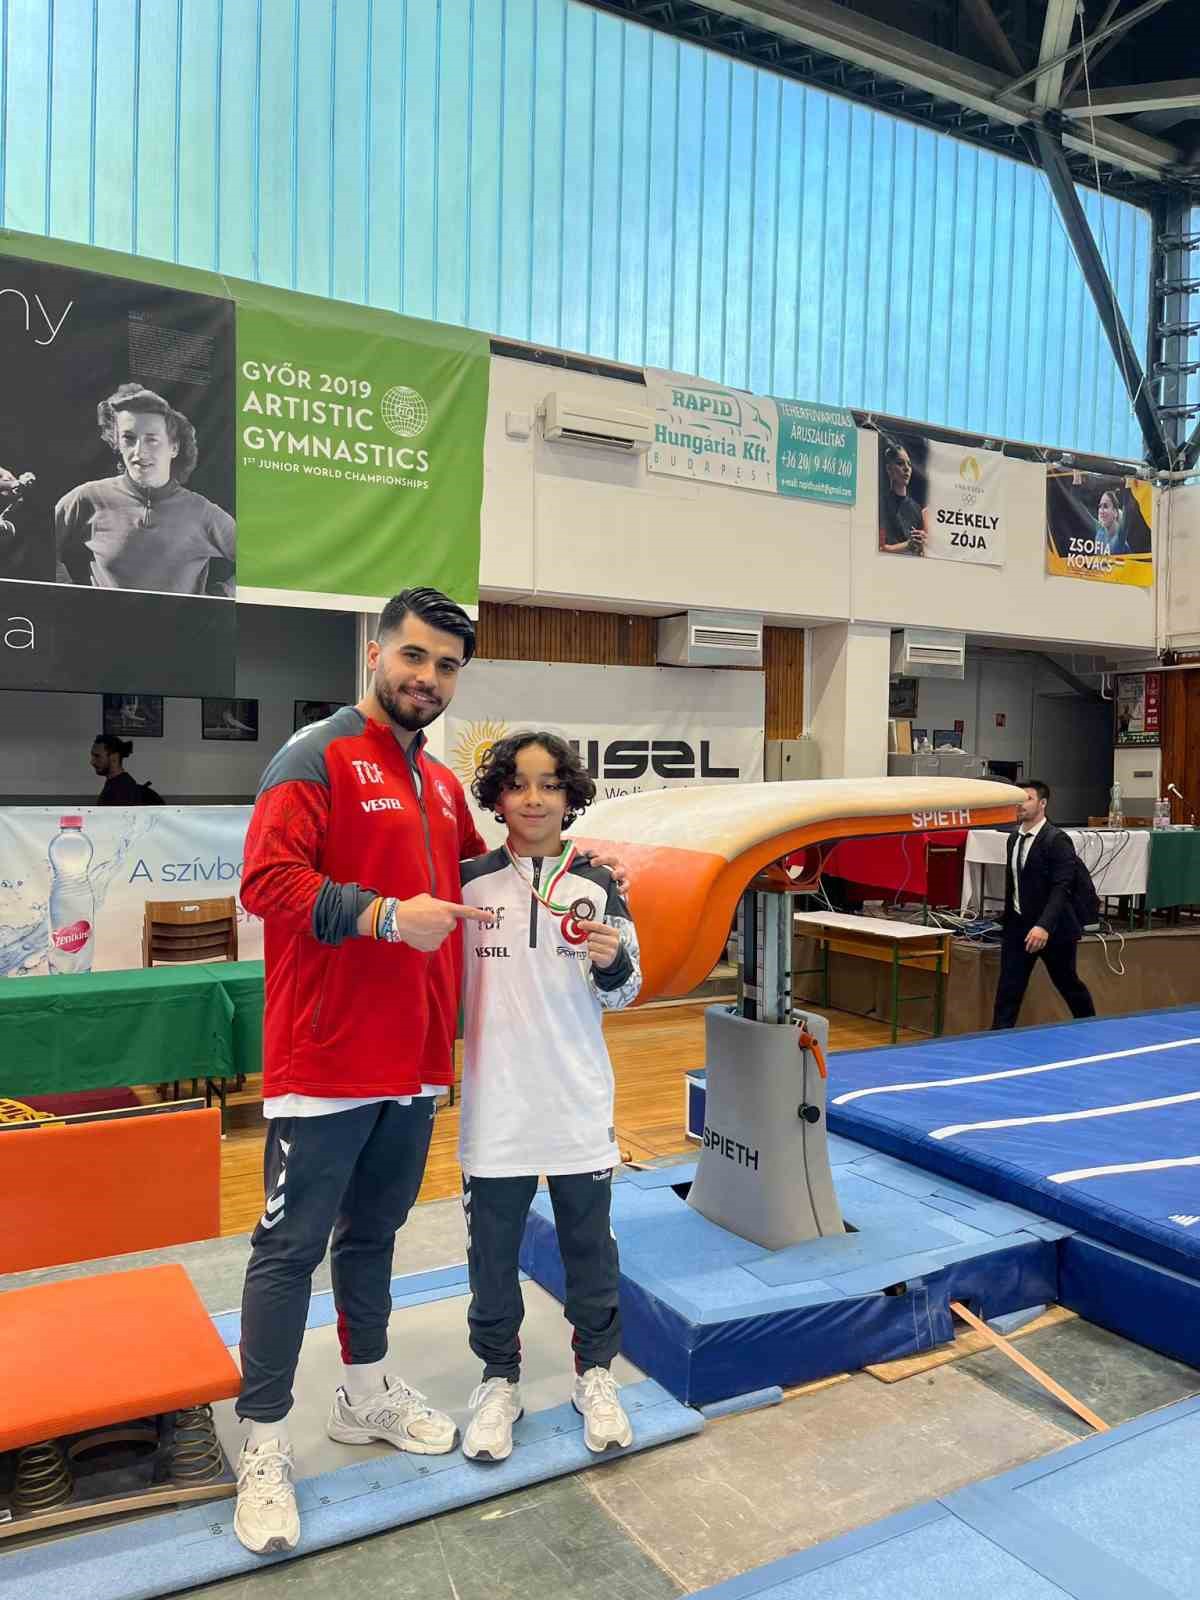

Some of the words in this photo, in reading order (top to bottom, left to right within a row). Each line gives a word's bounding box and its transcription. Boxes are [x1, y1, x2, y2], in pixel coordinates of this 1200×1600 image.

[242, 360, 312, 390] GYŐR
[319, 374, 372, 399] 2019
[242, 390, 374, 432] ARTISTIC
[672, 390, 733, 417] RAPID
[242, 426, 429, 473] GYMNASTICS
[655, 424, 736, 455] Hungária
[743, 441, 770, 464] Kft.
[257, 459, 300, 473] JUNIOR
[303, 464, 342, 479] WORLD
[344, 471, 429, 489] CHAMPIONSHIPS
[936, 506, 999, 530] SZÉKELY
[950, 531, 987, 549] ZÓJA
[361, 798, 405, 813] VESTEL
[911, 808, 970, 829] SPIETH
[129, 859, 153, 883] A
[475, 946, 511, 958] VESTEL
[703, 1126, 759, 1170] SPIETH
